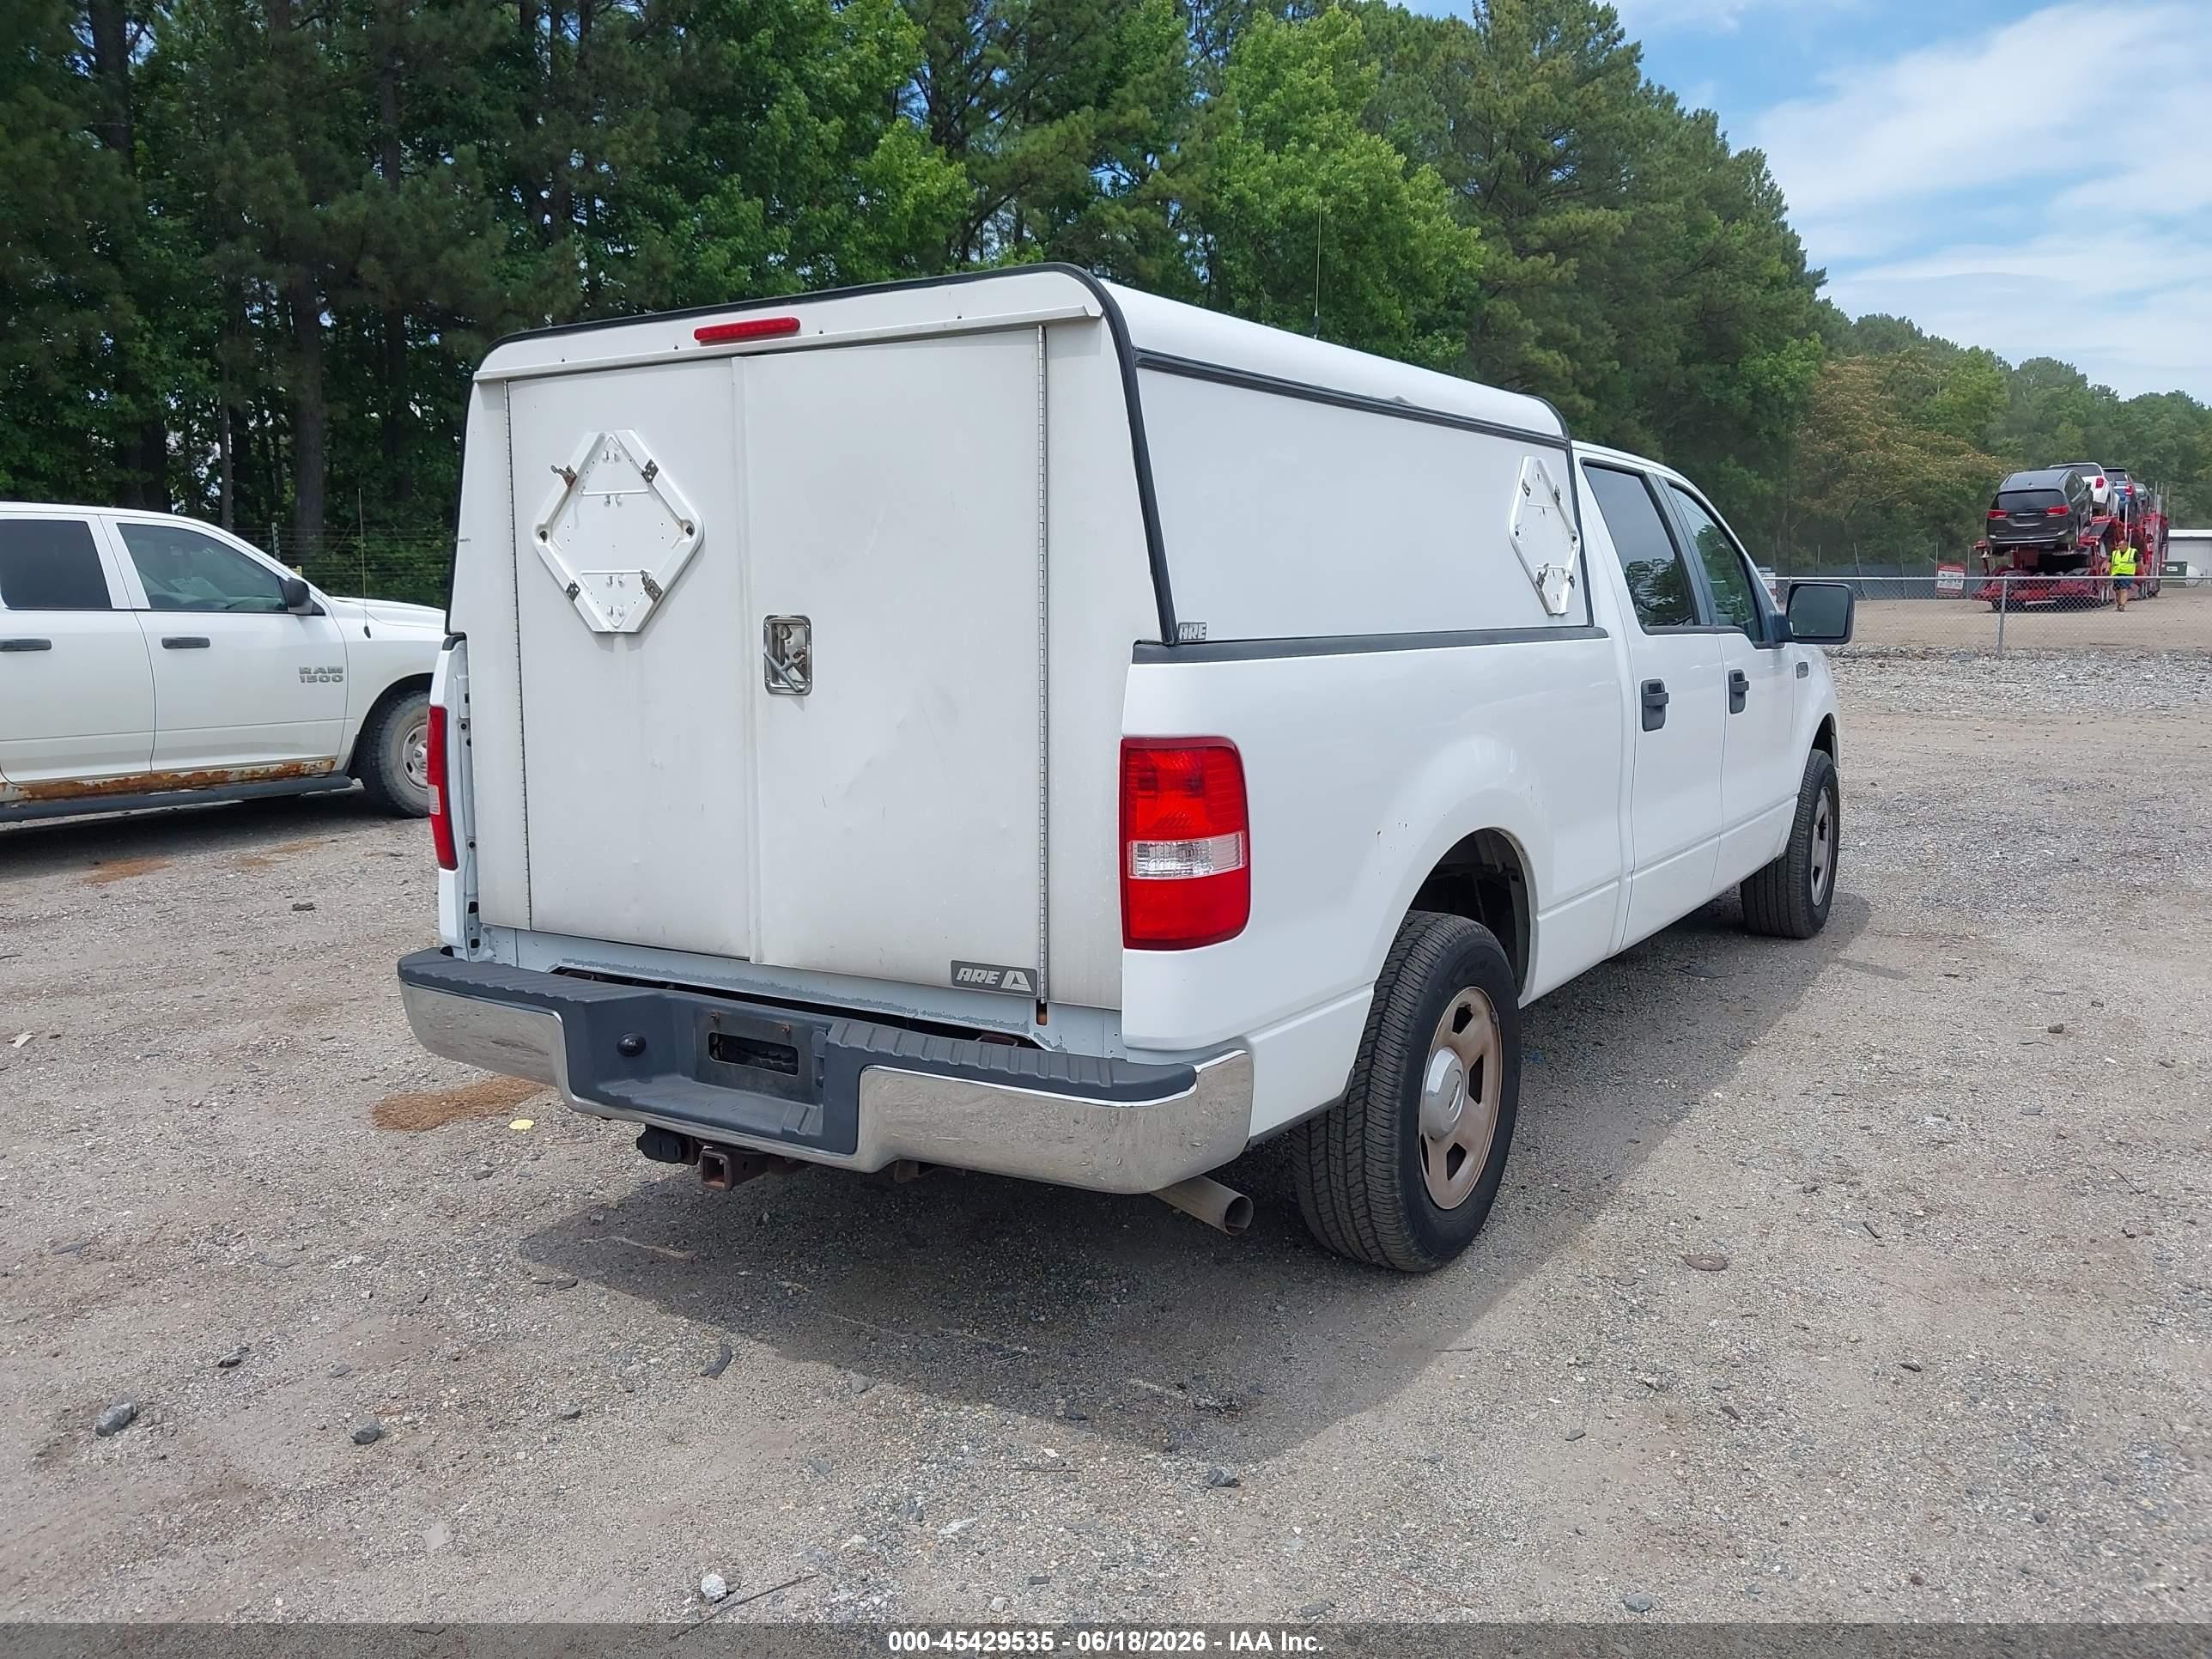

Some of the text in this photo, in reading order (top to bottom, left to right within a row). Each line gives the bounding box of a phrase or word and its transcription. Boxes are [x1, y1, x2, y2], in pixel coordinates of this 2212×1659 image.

[1179, 623, 1206, 640] ARE
[299, 665, 343, 674] RAM
[299, 675, 344, 684] 1500
